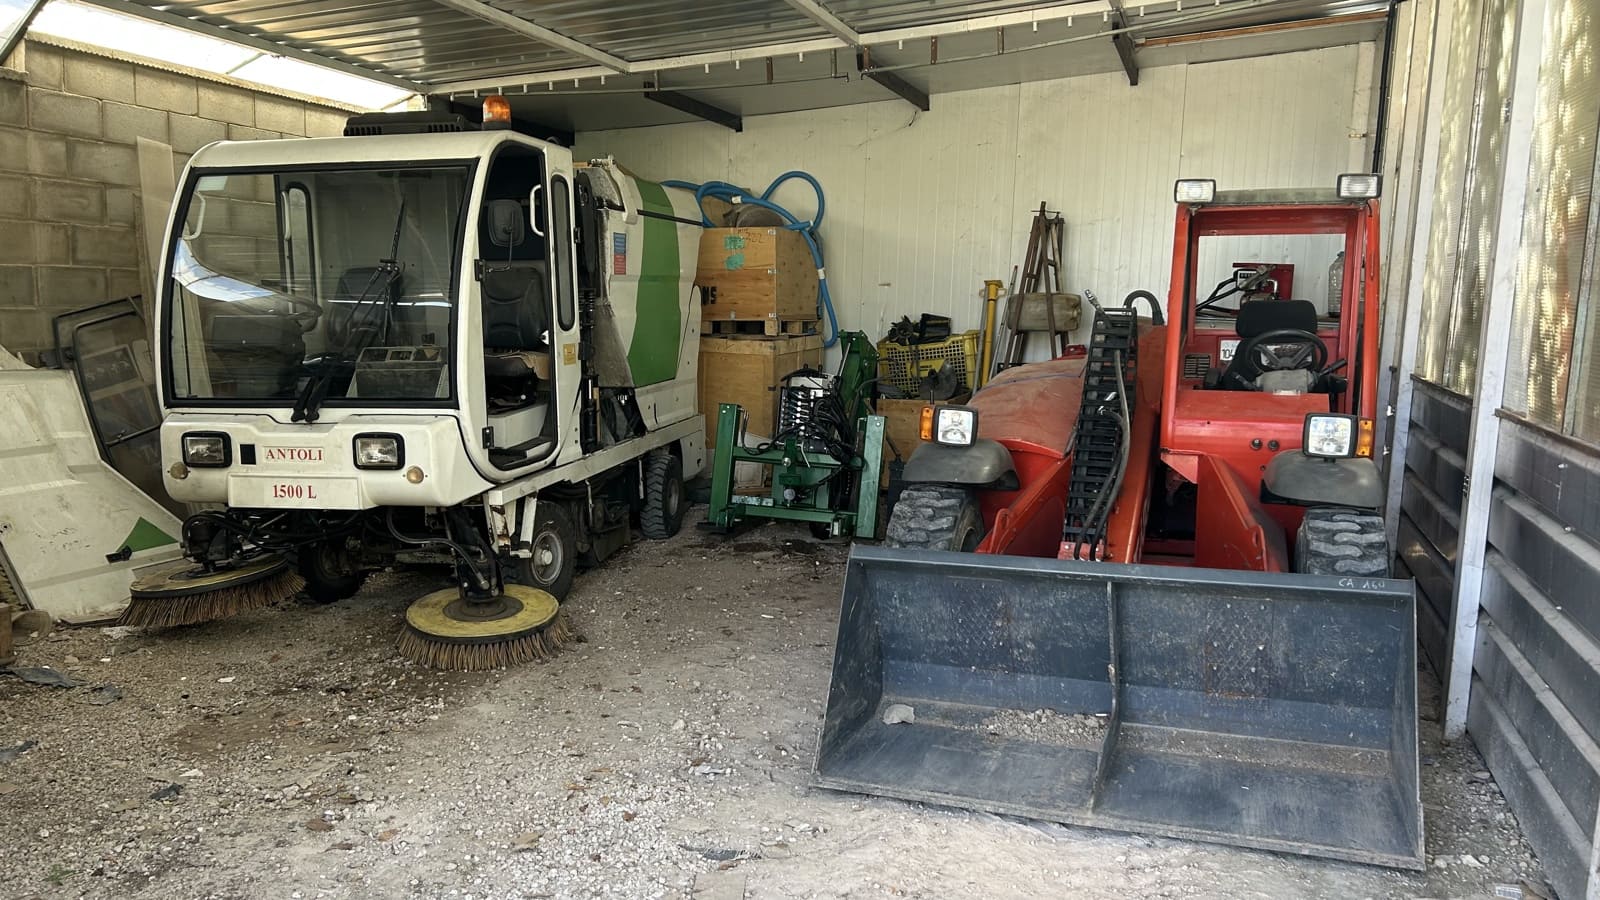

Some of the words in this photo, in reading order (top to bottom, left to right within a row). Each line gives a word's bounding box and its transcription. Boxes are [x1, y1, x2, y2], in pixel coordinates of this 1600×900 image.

[265, 448, 323, 461] ANTOLI
[272, 484, 303, 498] 1500
[307, 485, 317, 499] L
[1338, 578, 1354, 588] CA
